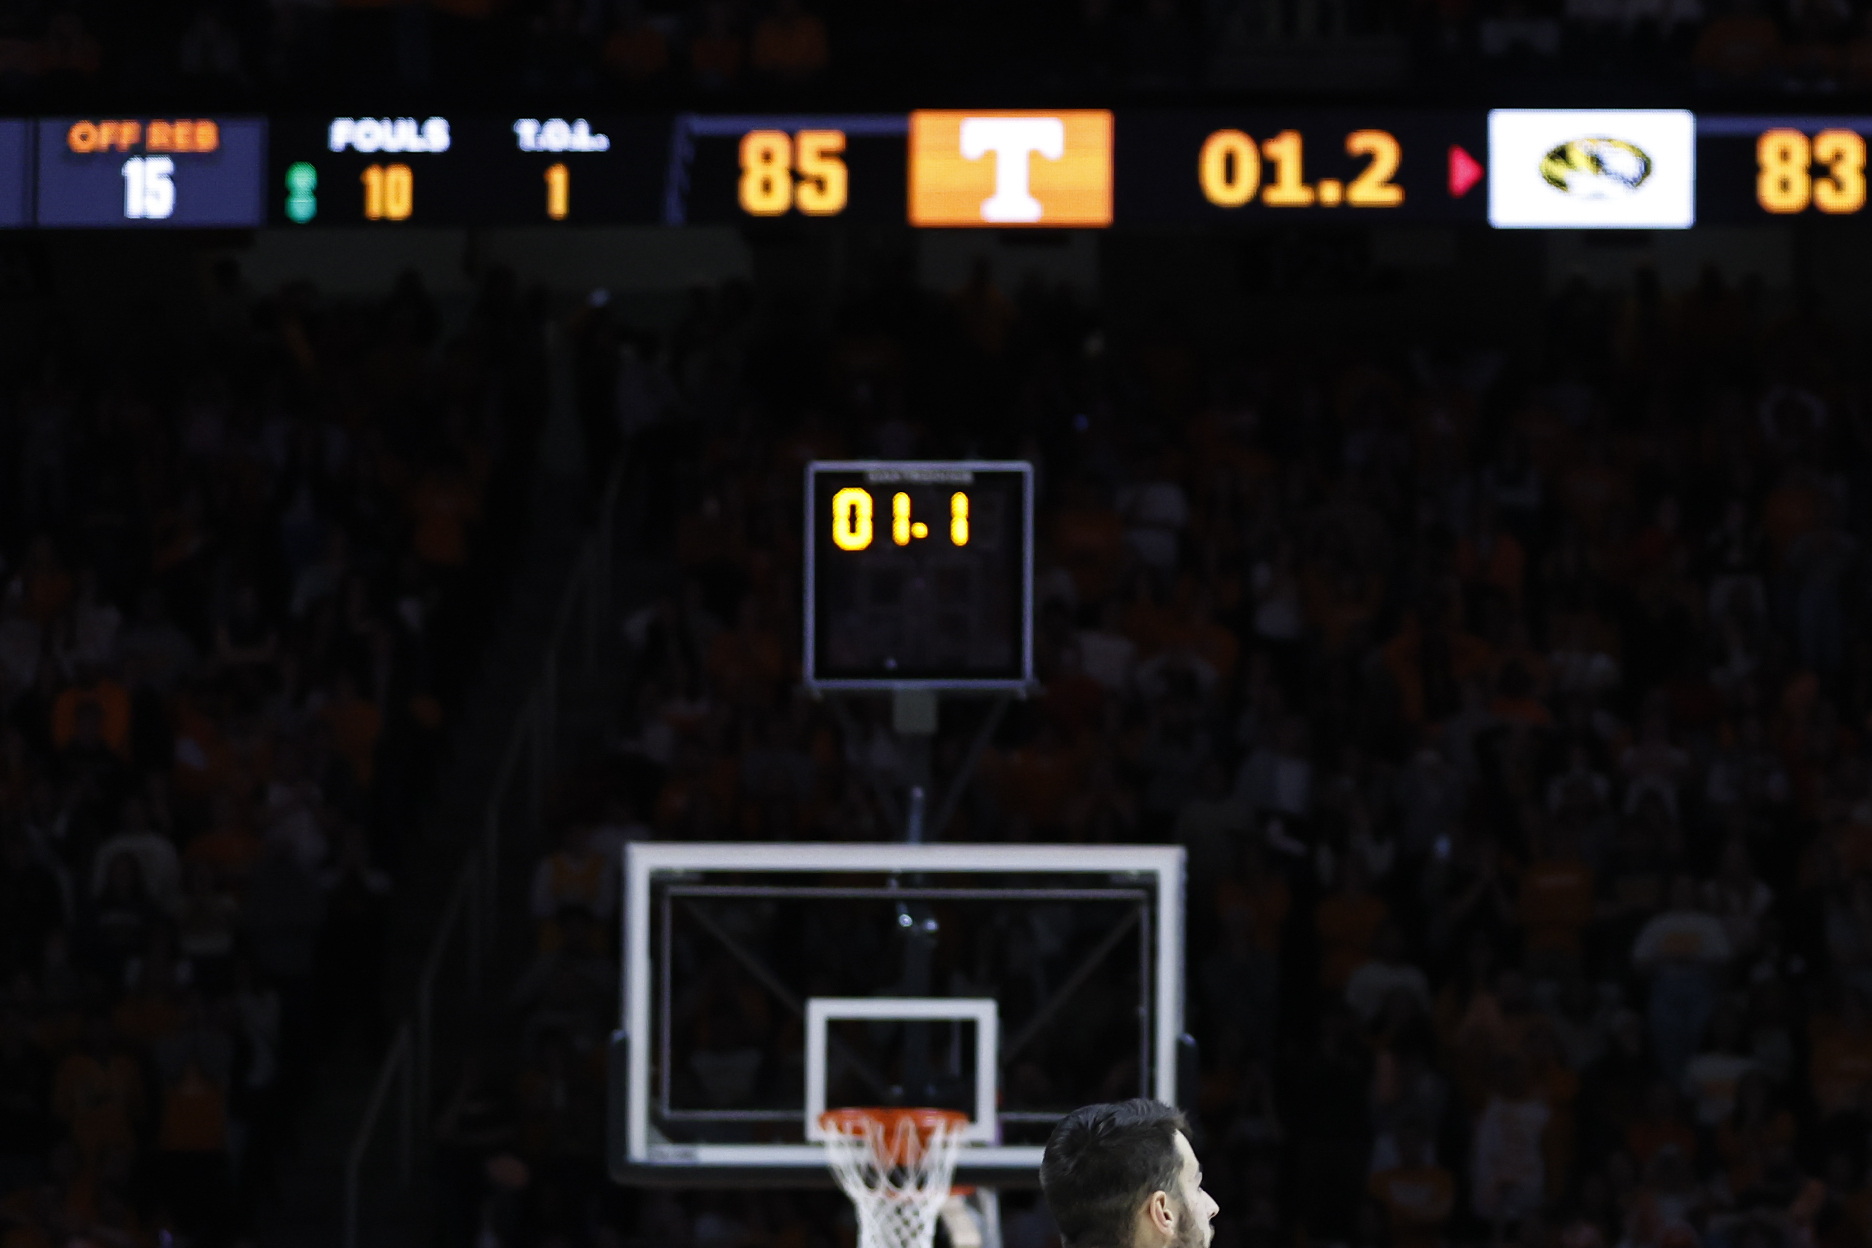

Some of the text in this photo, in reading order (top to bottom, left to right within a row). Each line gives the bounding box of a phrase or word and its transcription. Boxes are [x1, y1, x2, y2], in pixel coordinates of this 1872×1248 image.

[67, 119, 219, 154] OFF REB
[329, 116, 451, 154] FOULS
[515, 117, 610, 153] T.O.L.
[120, 155, 175, 220] 15
[363, 163, 414, 221] 10
[546, 163, 569, 219] 1
[738, 128, 849, 216] 85
[957, 115, 1068, 224] T
[1199, 128, 1404, 207] 01.2
[1756, 127, 1868, 214] 83
[832, 487, 968, 551] 01.1
